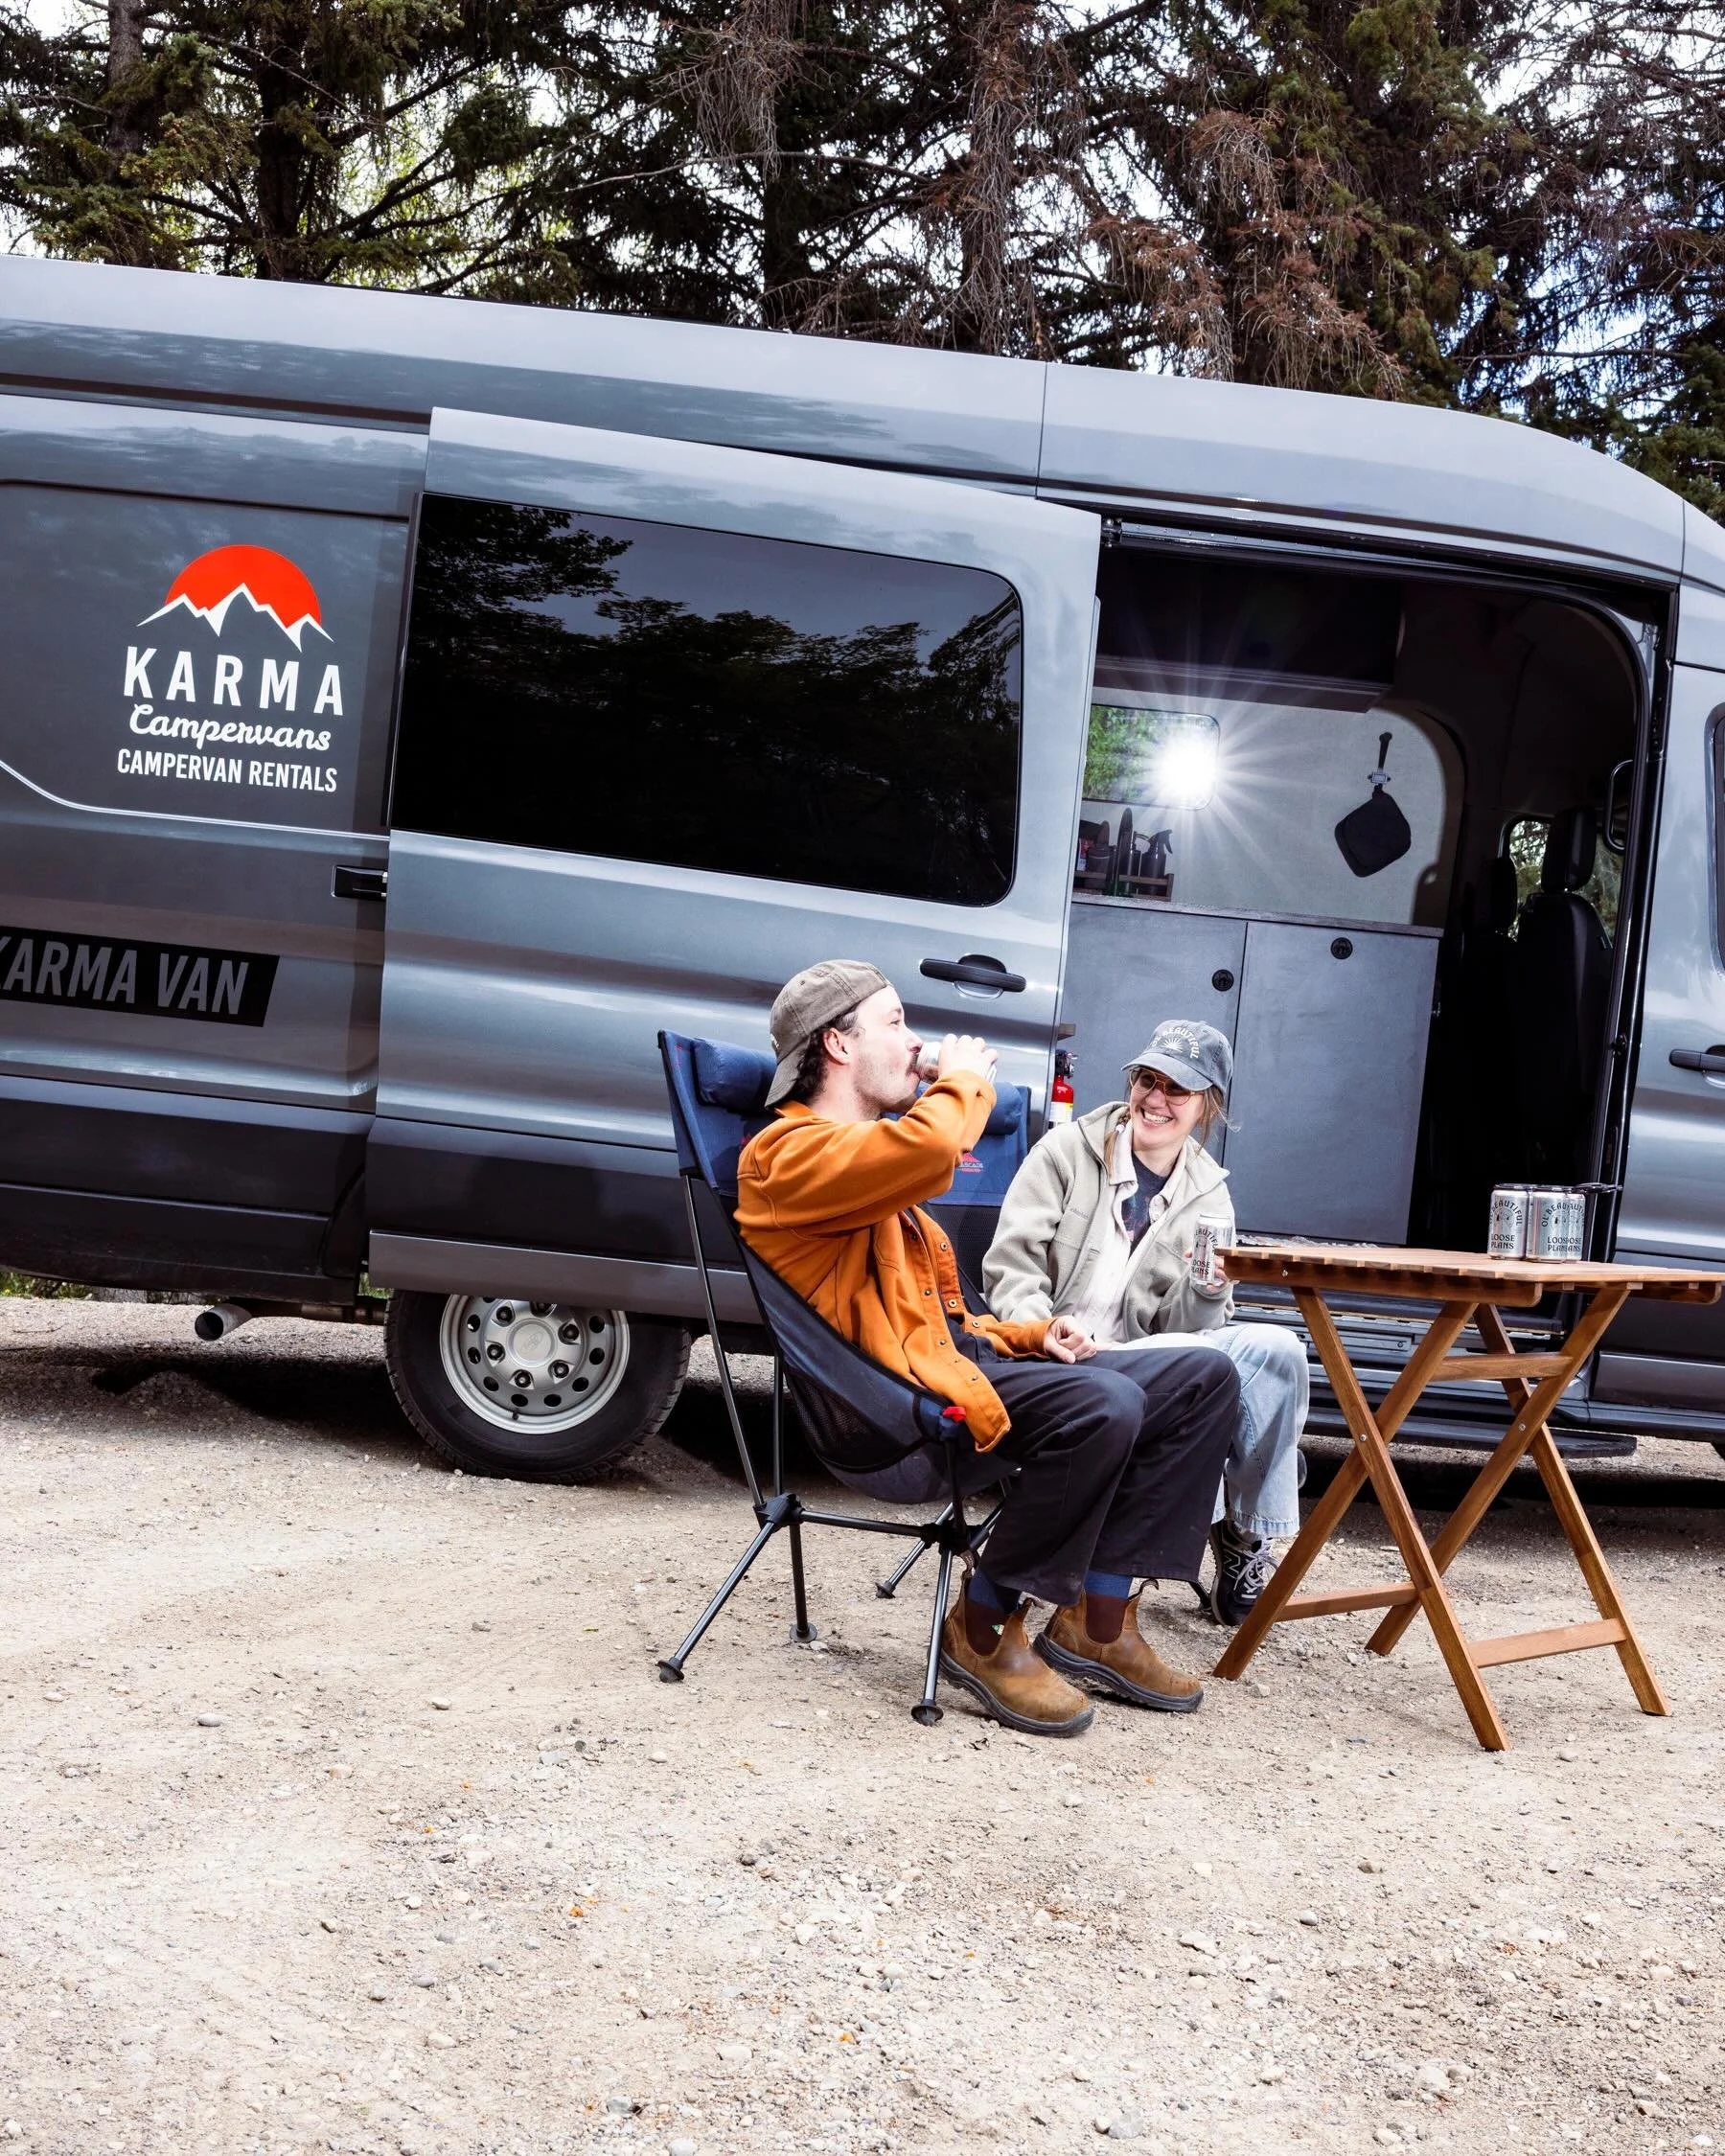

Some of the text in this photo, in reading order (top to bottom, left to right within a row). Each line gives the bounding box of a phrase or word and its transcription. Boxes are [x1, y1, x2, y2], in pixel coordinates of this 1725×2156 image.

[124, 646, 343, 716] KARMA
[129, 703, 332, 751] Campervans
[118, 748, 337, 792] CAMPERVAN RENTALS
[157, 952, 249, 1015] VAN
[1192, 1259, 1210, 1268] OOSE
[1490, 1241, 1514, 1250] PLANS
